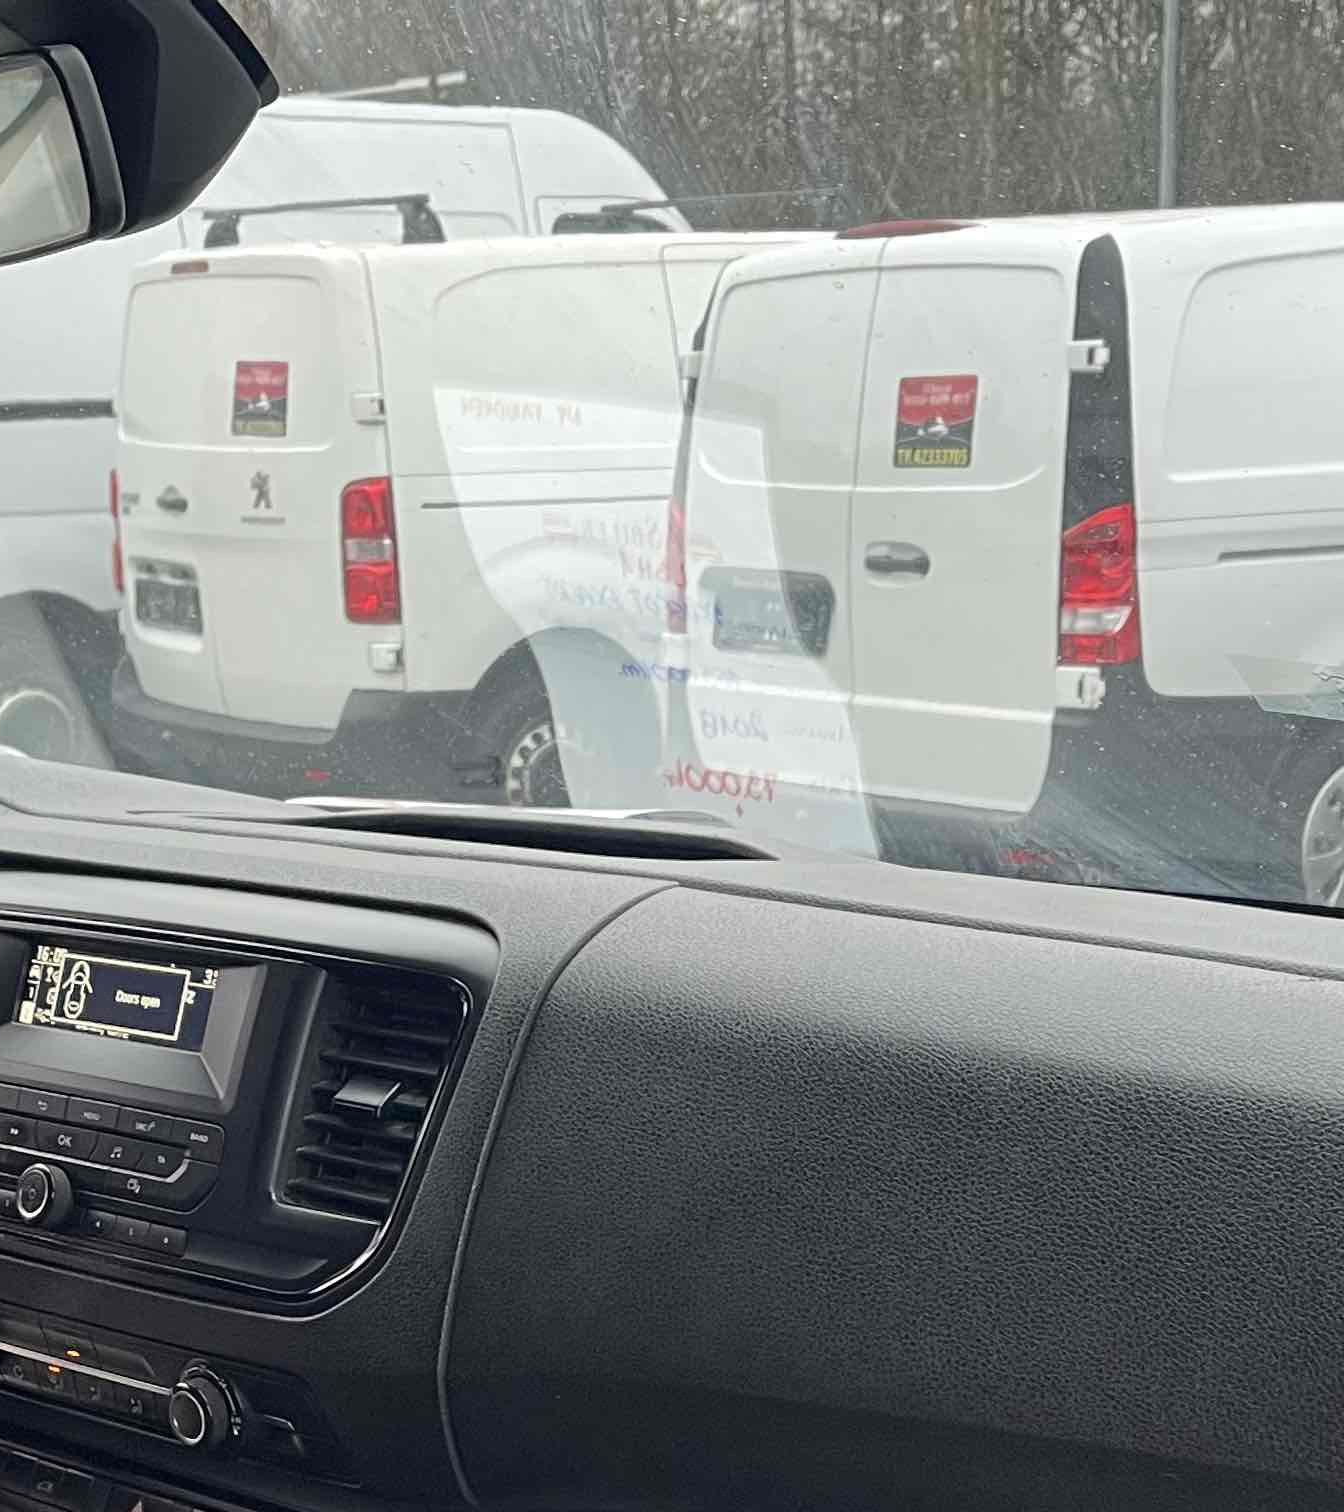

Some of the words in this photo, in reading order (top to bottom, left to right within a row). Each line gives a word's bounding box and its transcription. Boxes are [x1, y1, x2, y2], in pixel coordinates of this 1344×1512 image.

[115, 989, 140, 1006] Doors
[140, 994, 161, 1009] open
[57, 1134, 73, 1148] OK
